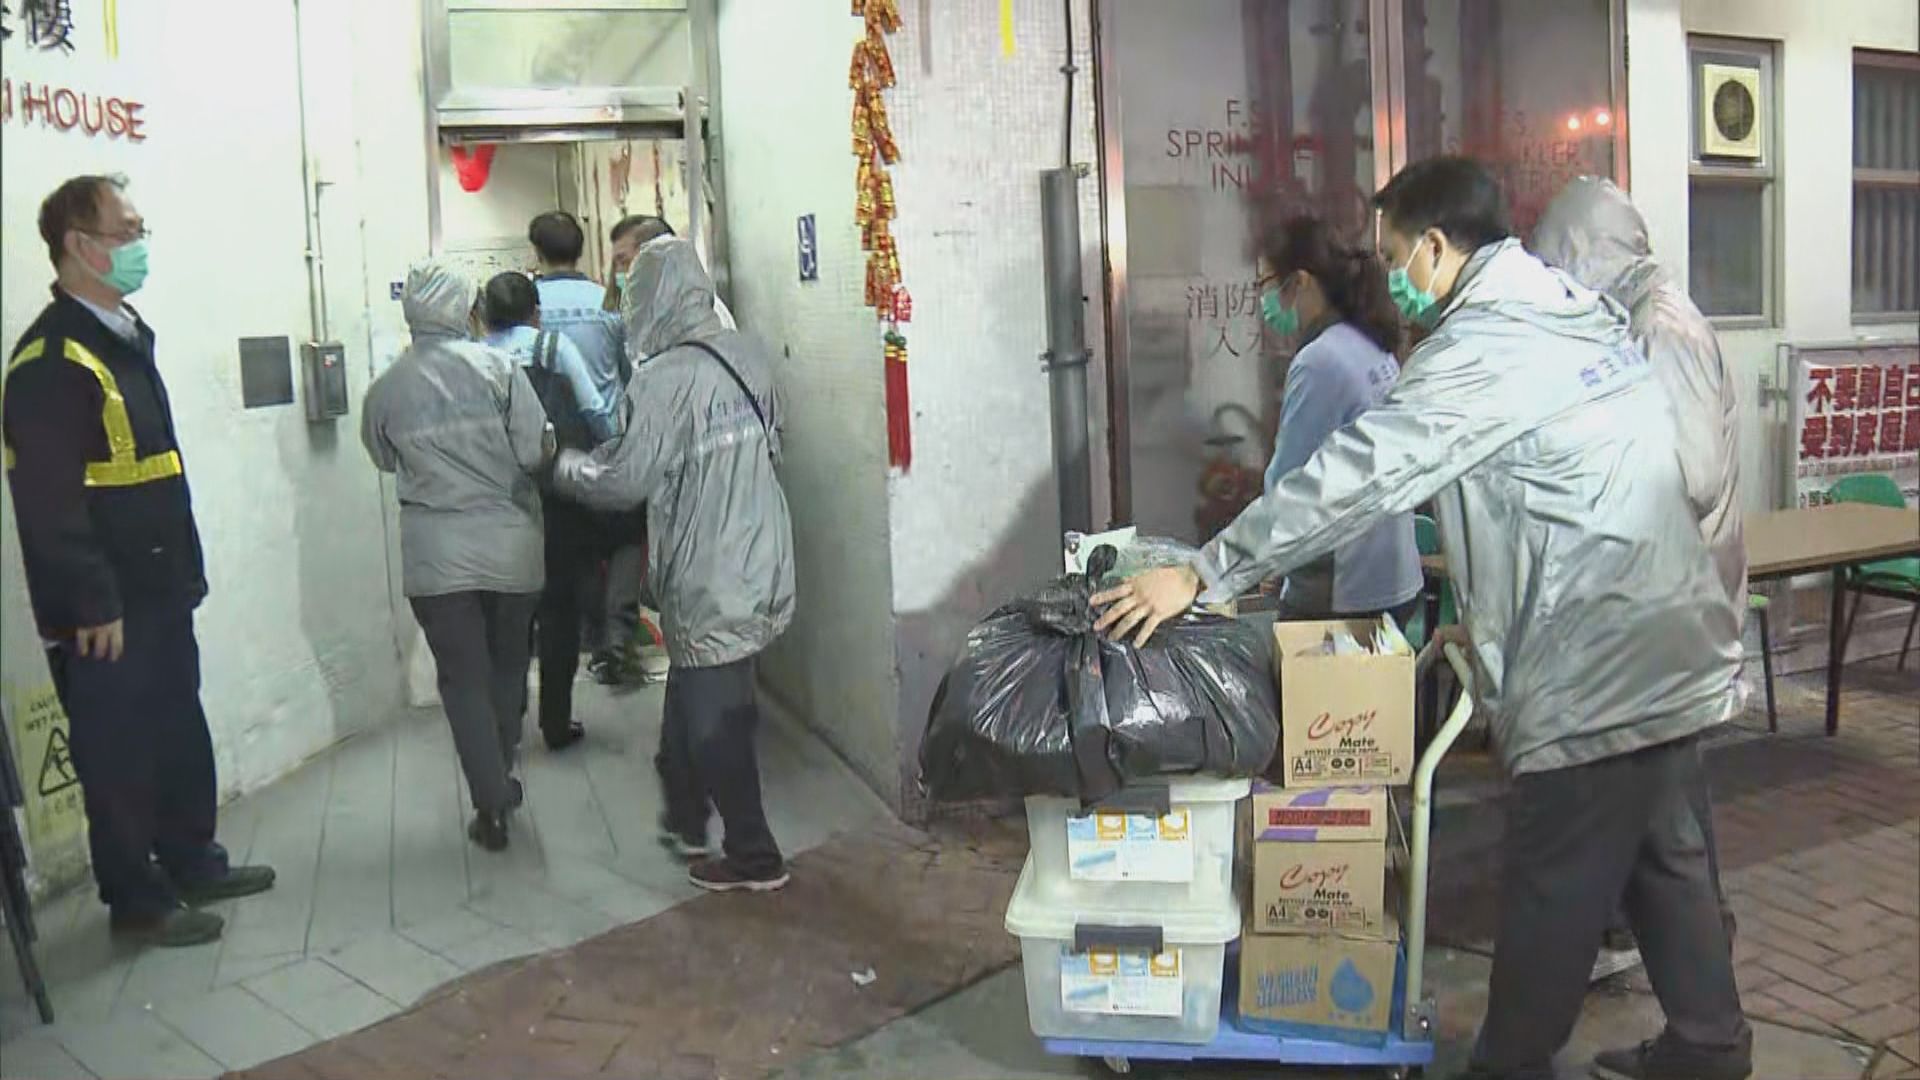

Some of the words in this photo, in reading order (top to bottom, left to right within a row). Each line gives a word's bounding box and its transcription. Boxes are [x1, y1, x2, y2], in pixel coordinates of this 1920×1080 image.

[24, 81, 147, 141] HOUSE
[1307, 709, 1377, 740] Copy
[1339, 737, 1375, 748] Mate
[1294, 758, 1312, 773] A4
[1279, 864, 1350, 889] Copy
[1313, 889, 1350, 899] Mate
